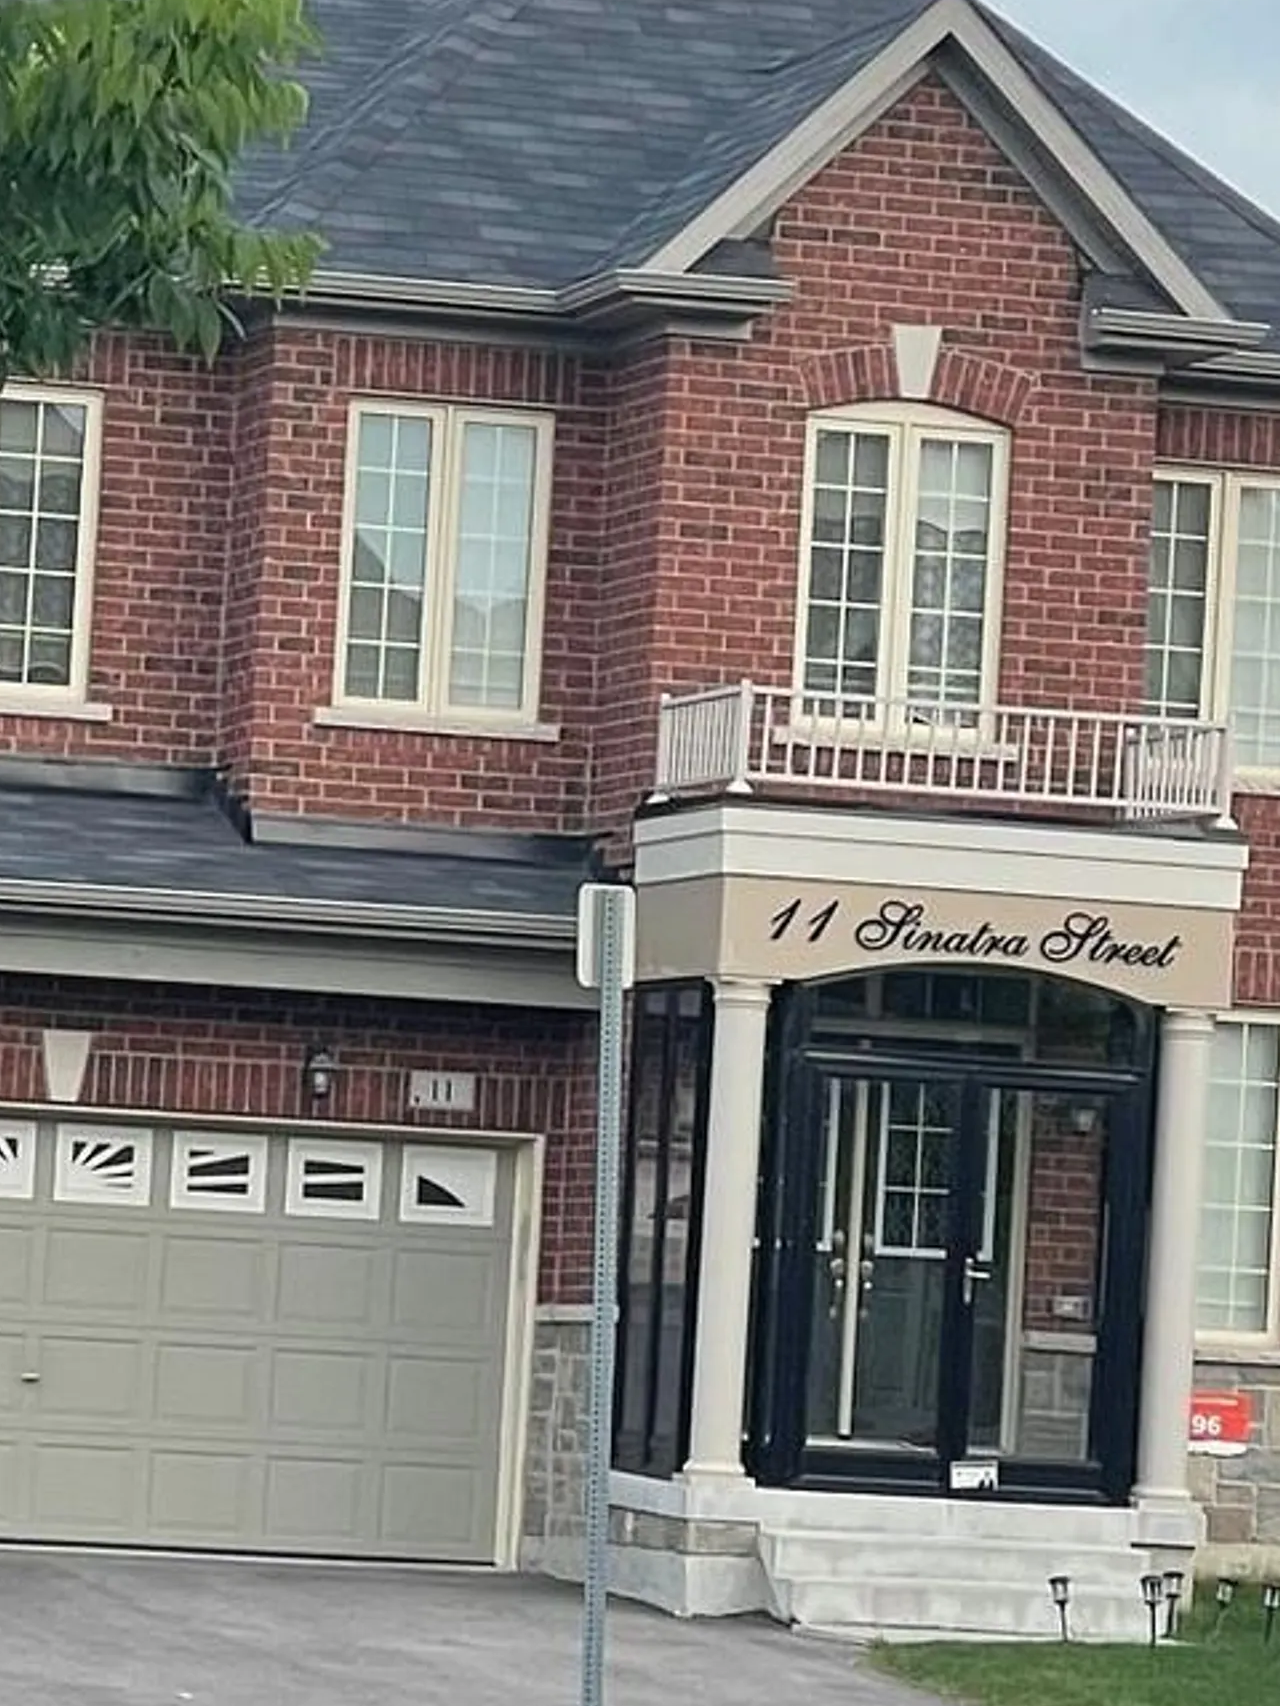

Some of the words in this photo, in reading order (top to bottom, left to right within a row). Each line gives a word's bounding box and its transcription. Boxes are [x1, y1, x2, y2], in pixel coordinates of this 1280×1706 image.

[770, 899, 839, 941] 11
[855, 900, 1029, 957] Sinatra
[1039, 912, 1183, 967] Street
[431, 1078, 452, 1102] 11
[1191, 1414, 1222, 1436] 96
